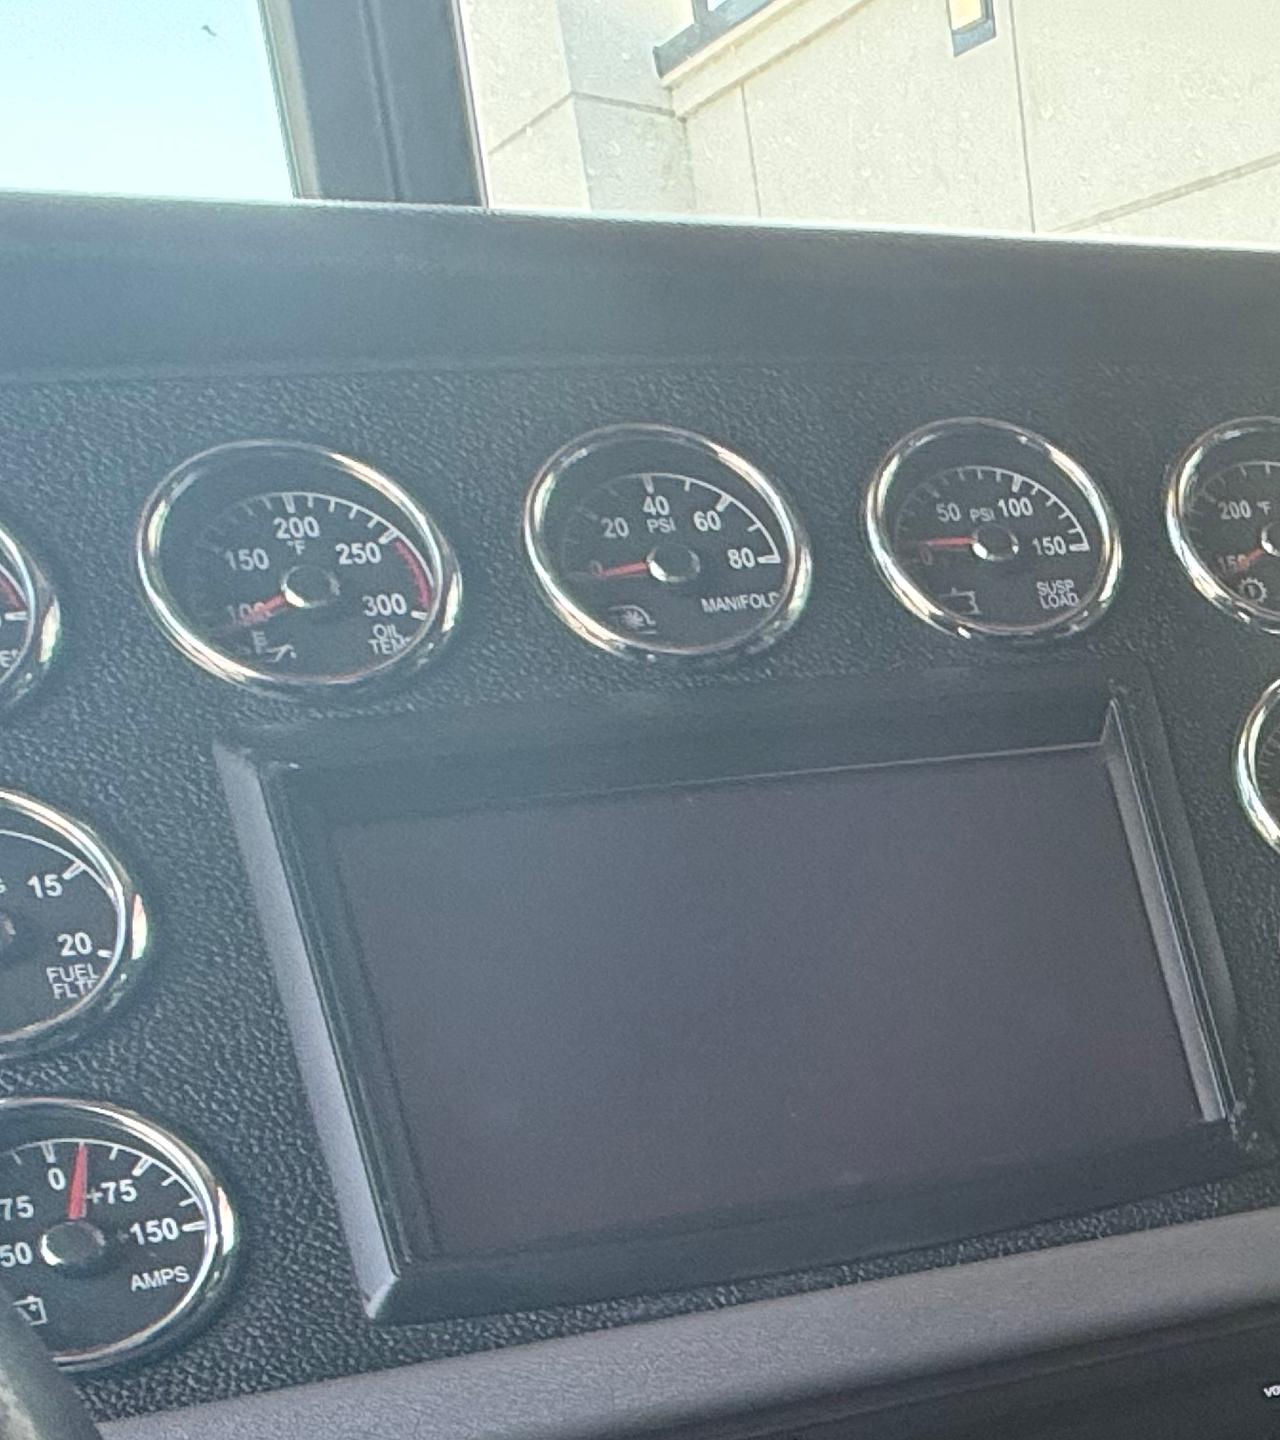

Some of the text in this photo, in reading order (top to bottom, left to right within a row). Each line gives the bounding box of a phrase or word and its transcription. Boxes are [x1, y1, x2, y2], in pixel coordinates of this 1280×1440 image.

[642, 495, 670, 516] 40
[936, 502, 962, 522] 50
[969, 507, 996, 522] PSI
[998, 497, 1034, 518] 100
[1218, 501, 1251, 520] 200
[273, 516, 320, 539] 200
[601, 517, 630, 539] 20
[646, 517, 677, 534] PSI
[693, 510, 722, 532] 60
[335, 541, 382, 565] 250
[1032, 536, 1066, 556] 150
[225, 548, 270, 571] 150
[727, 547, 756, 570] 80
[1036, 579, 1075, 597] SUSP
[362, 592, 408, 617] 300
[1041, 594, 1080, 610] LOAD
[373, 623, 402, 642] OIL
[26, 874, 63, 898] 15
[57, 932, 93, 957] 20
[46, 963, 99, 985] FUEL
[47, 1167, 67, 1190] 0
[131, 1265, 190, 1292] AMPS
